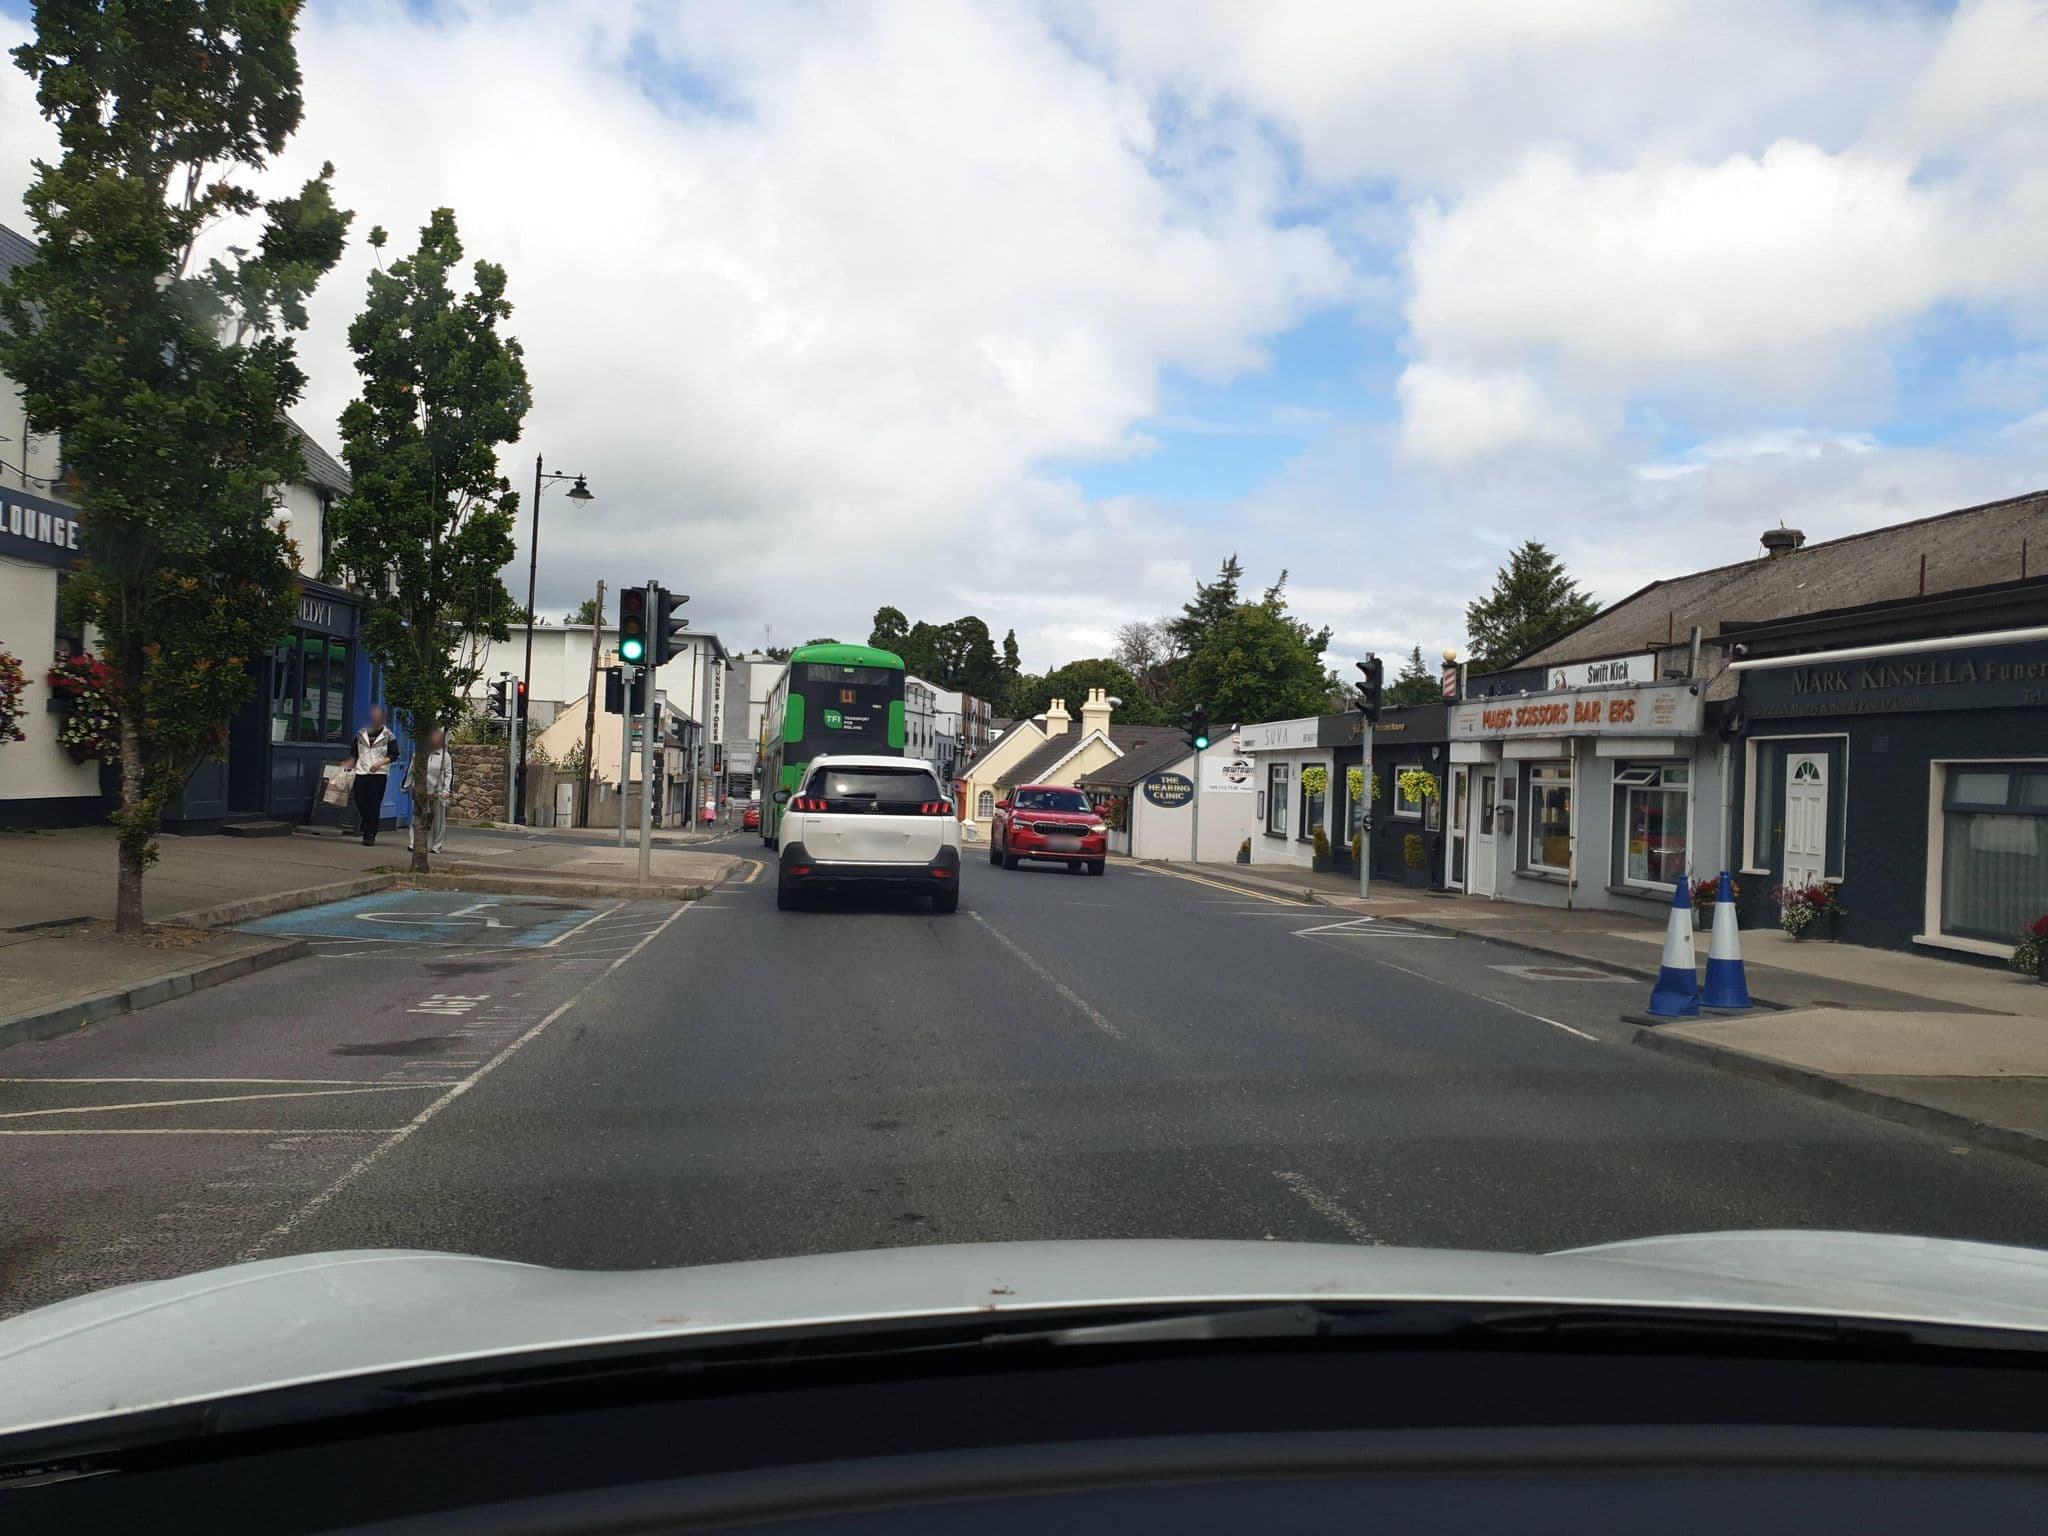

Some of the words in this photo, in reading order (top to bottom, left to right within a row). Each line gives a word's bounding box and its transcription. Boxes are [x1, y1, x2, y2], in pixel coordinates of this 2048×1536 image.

[0, 500, 79, 550] LOUNGE
[1588, 664, 1608, 684] Swift
[1610, 661, 1629, 681] Kick
[1792, 670, 1849, 695] MARK
[1861, 660, 1978, 689] KINSELLA
[1482, 707, 1513, 729] MAGIC
[1515, 702, 1569, 727] SCISSORS
[1264, 728, 1289, 746] SUVA
[1148, 783, 1191, 792] HEARING
[1161, 776, 1179, 784] THE
[1153, 791, 1185, 799] CLINIC
